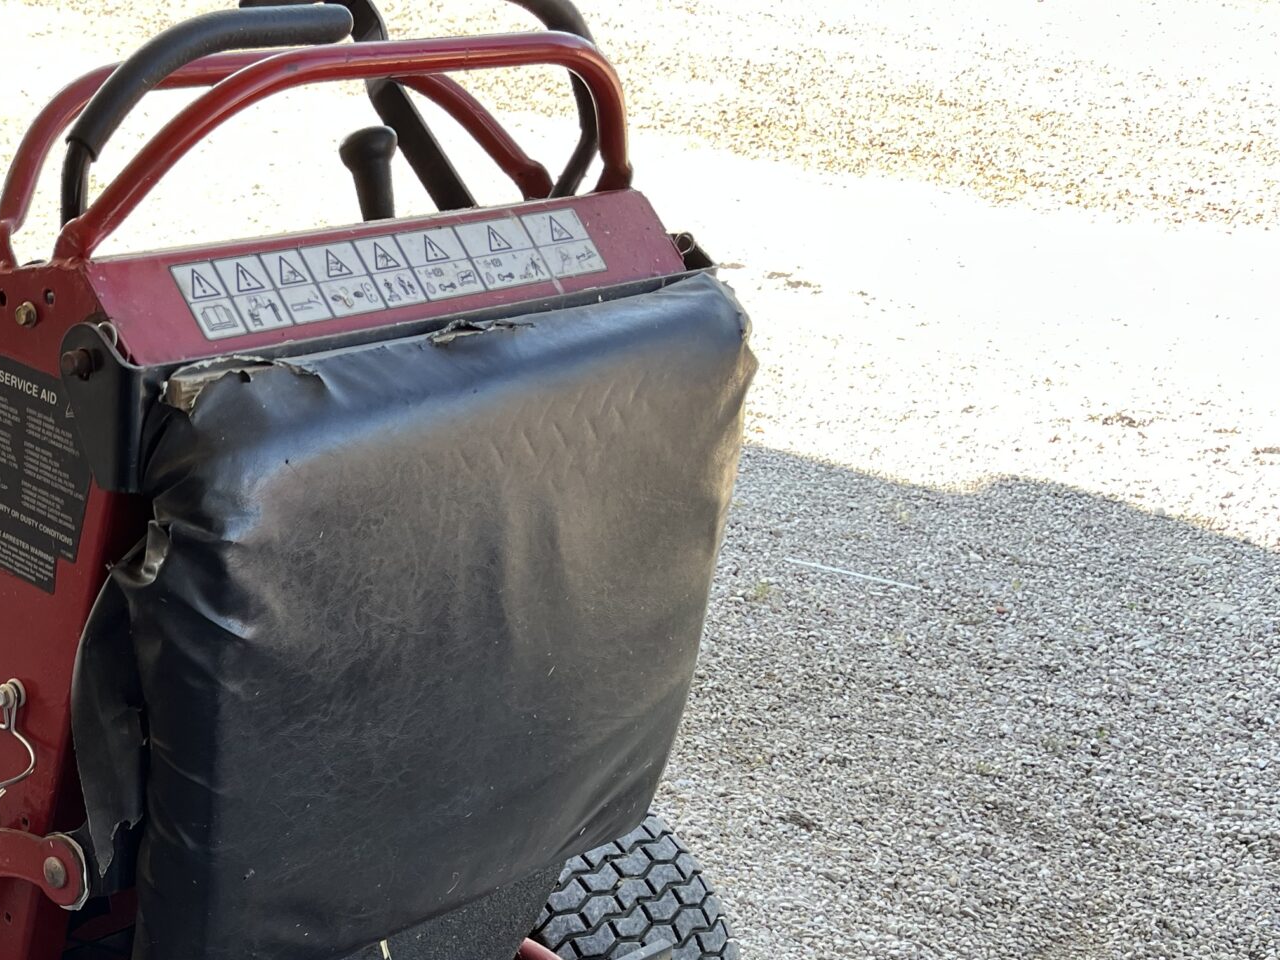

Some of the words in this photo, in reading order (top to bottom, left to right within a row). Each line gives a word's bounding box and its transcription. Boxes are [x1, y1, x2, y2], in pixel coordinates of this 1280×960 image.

[40, 388, 57, 404] AID
[11, 509, 20, 519] OR
[21, 514, 38, 528] DUSTY
[39, 524, 72, 546] CONDITIONS
[3, 531, 29, 550] ARRESTER
[30, 544, 54, 561] WARNING
